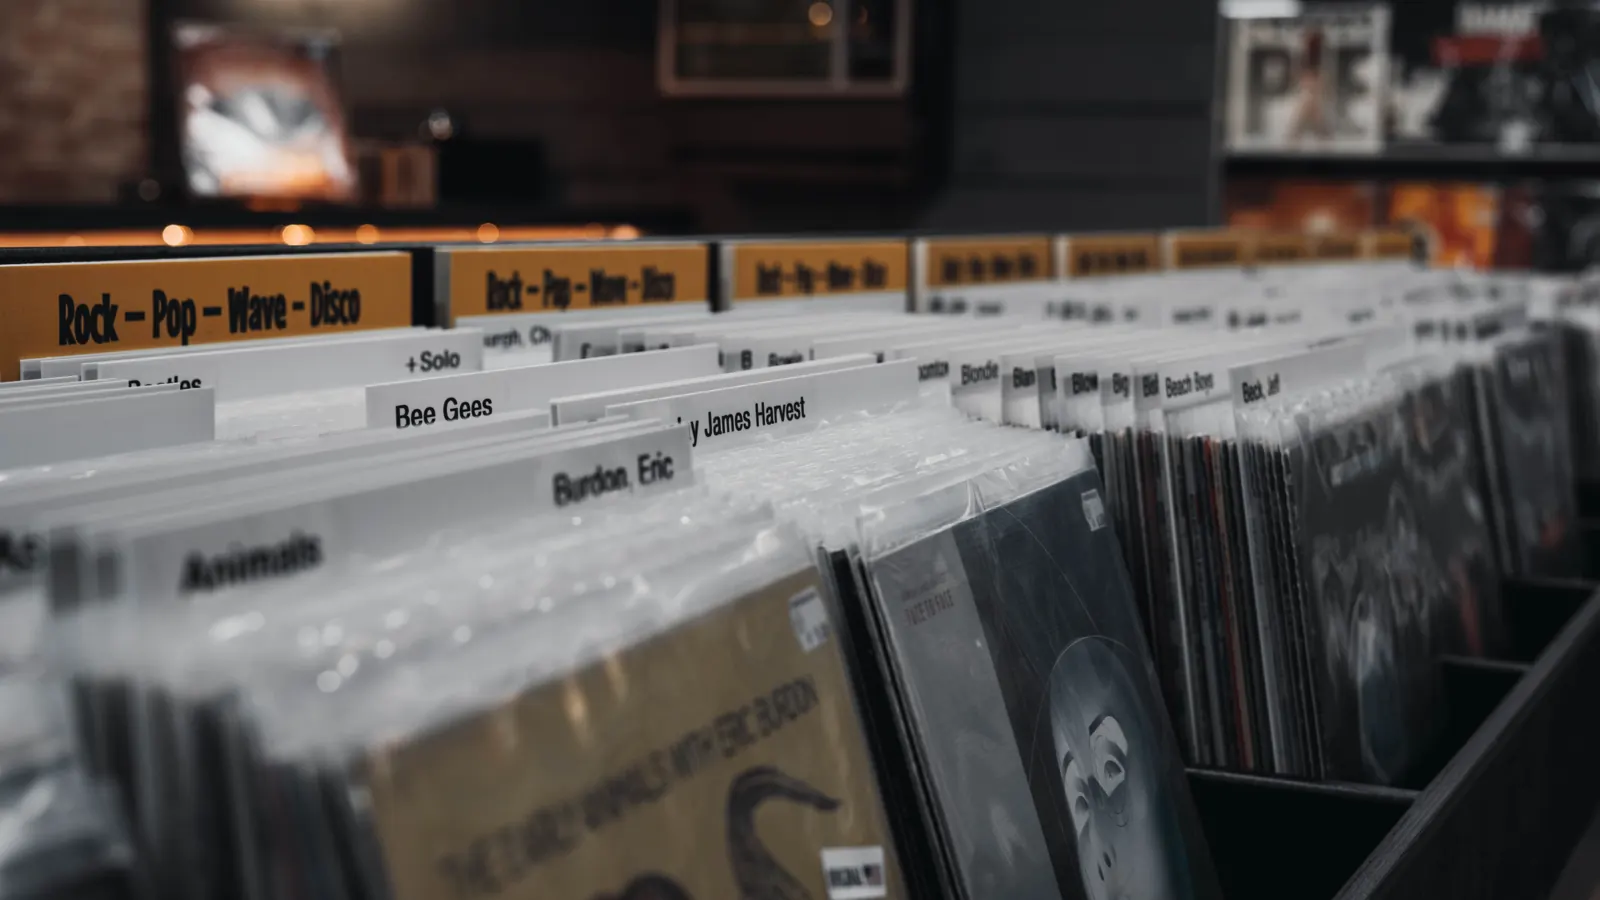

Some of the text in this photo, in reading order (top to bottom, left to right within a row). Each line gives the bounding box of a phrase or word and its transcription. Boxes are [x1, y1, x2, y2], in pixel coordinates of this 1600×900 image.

[58, 293, 119, 346] Rock
[152, 289, 197, 346] Pop
[227, 285, 287, 334] Wave
[310, 280, 361, 327] Disco
[395, 397, 493, 429] Bee Gees
[704, 411, 751, 438] James
[755, 396, 806, 427] Harvest
[637, 450, 675, 486] Eric
[180, 531, 323, 595] Animals
